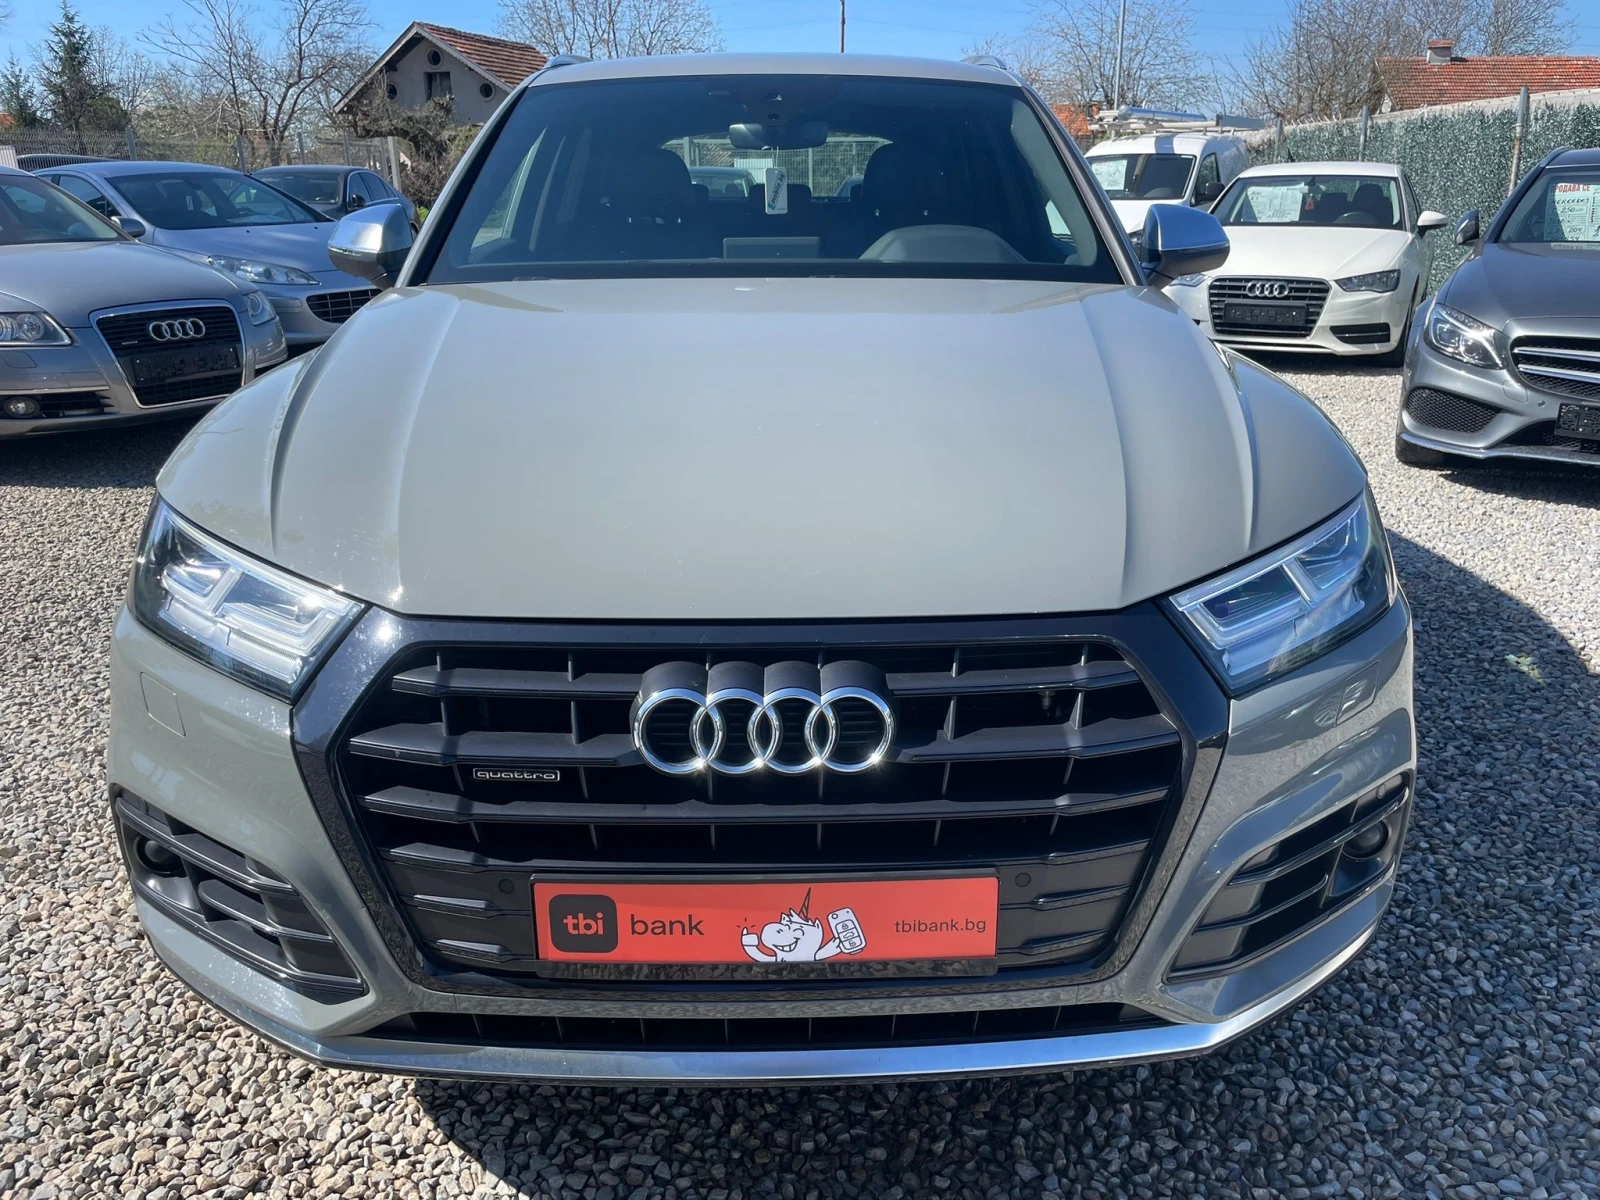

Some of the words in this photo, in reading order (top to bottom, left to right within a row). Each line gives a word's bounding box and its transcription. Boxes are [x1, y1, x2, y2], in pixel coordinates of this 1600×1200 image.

[477, 771, 555, 779] quattro
[563, 912, 604, 935] tbi
[630, 914, 705, 936] bank
[895, 918, 986, 933] tbibank.bg
